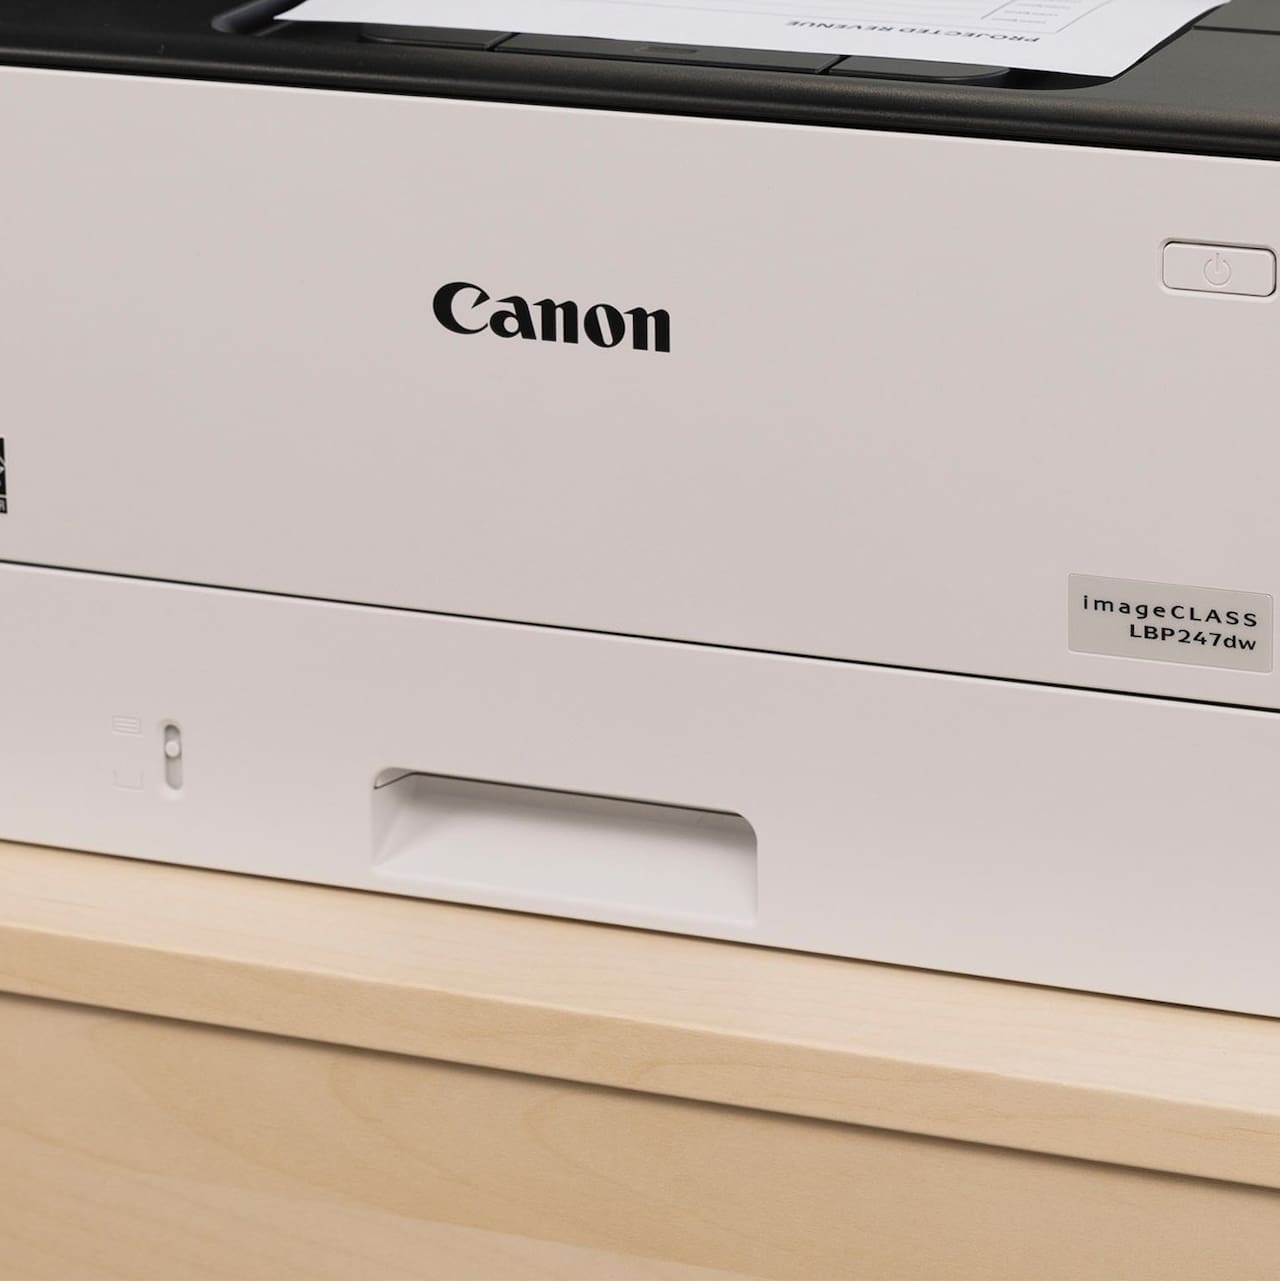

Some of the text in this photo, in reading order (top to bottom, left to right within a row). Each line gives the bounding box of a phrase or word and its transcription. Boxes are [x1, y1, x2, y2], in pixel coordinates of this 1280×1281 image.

[786, 20, 1041, 43] PROJECTED REVENUE
[432, 281, 671, 353] Canon
[1082, 594, 1258, 628] imageCLASS
[1129, 623, 1257, 651] LBP247dw
